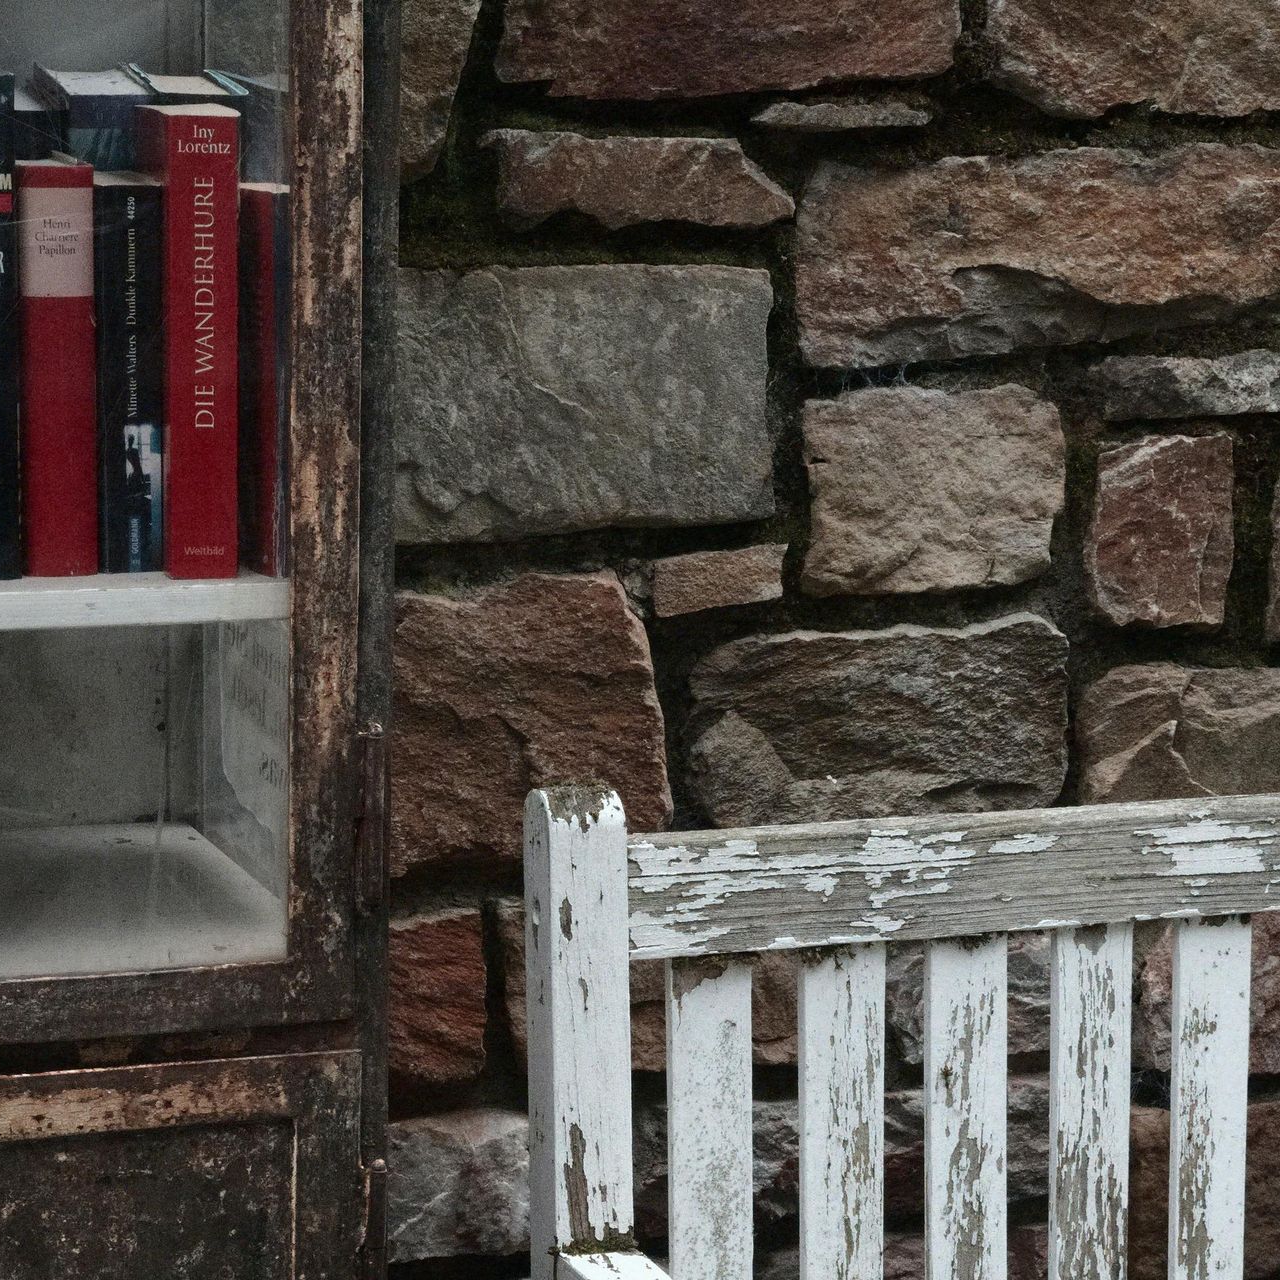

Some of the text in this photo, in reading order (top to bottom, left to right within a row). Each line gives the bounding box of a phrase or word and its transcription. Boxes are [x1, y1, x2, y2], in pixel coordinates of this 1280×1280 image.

[191, 123, 216, 144] Iny
[175, 137, 232, 155] Lorentz
[42, 218, 72, 229] Henri
[38, 244, 77, 258] Papillon
[126, 196, 138, 419] Minette Walters Dunkle Kammern 44250
[194, 176, 216, 430] DIE WANDERHURE
[183, 545, 225, 557] Weltbild
